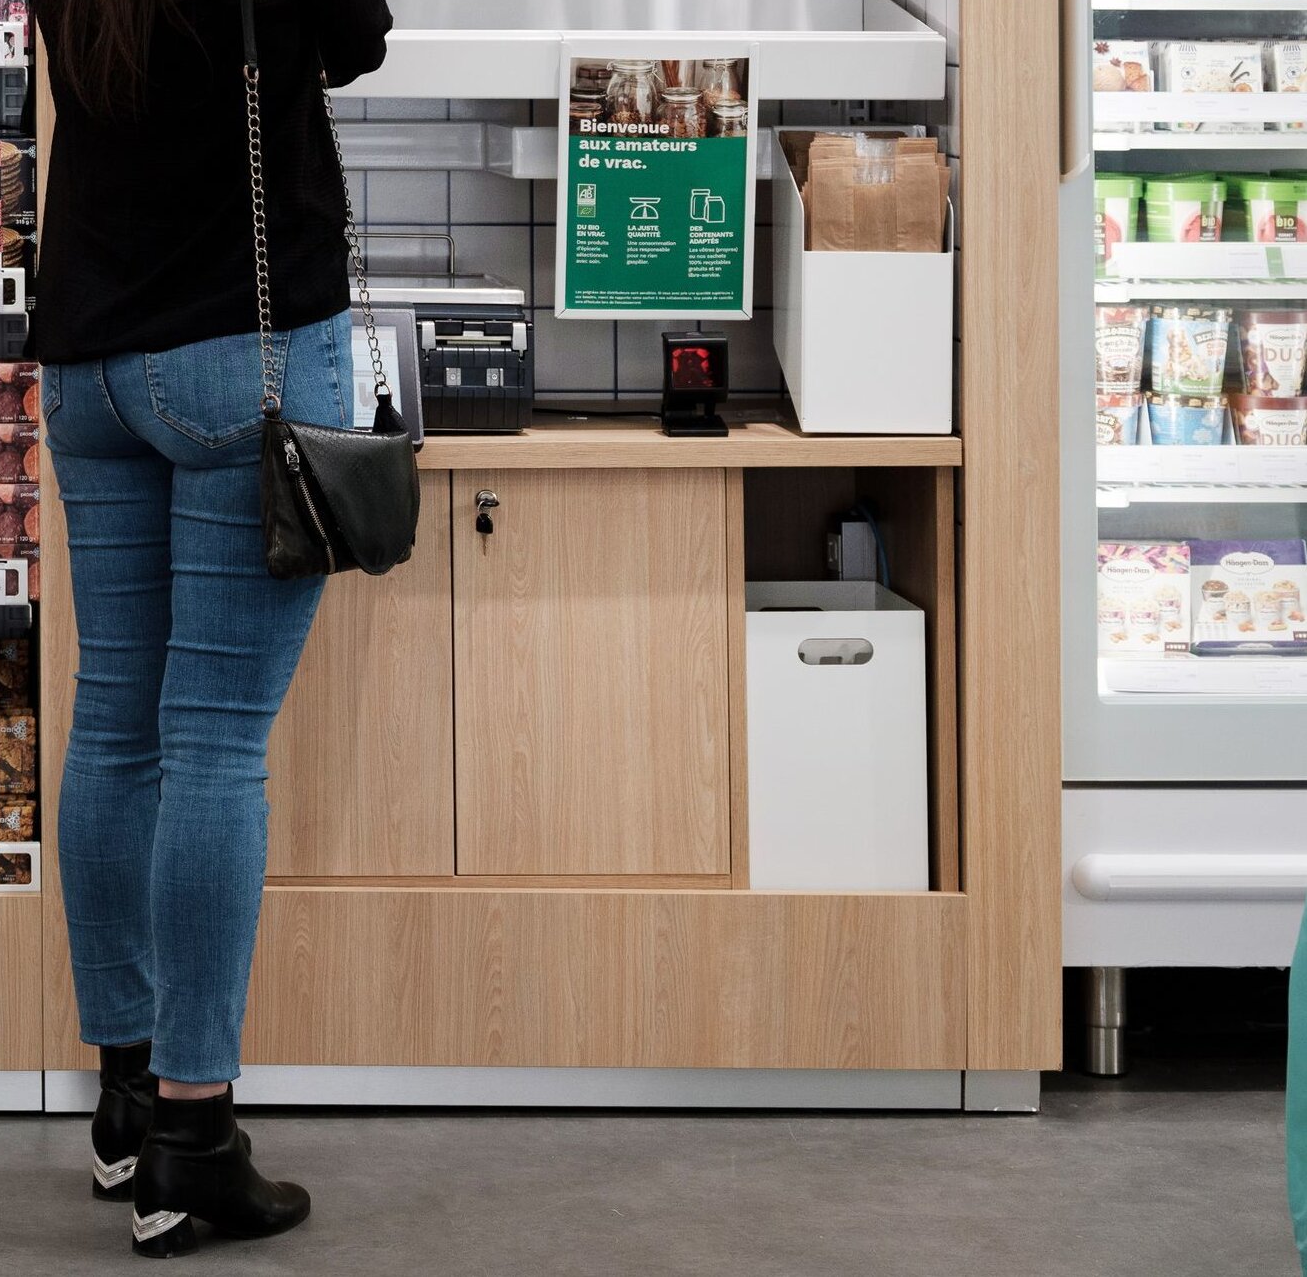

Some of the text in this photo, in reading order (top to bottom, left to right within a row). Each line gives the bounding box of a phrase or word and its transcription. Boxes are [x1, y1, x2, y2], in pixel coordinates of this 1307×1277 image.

[580, 119, 670, 134] Bienvenue
[579, 140, 697, 152] aux amateurs
[579, 154, 647, 169] de vrac.
